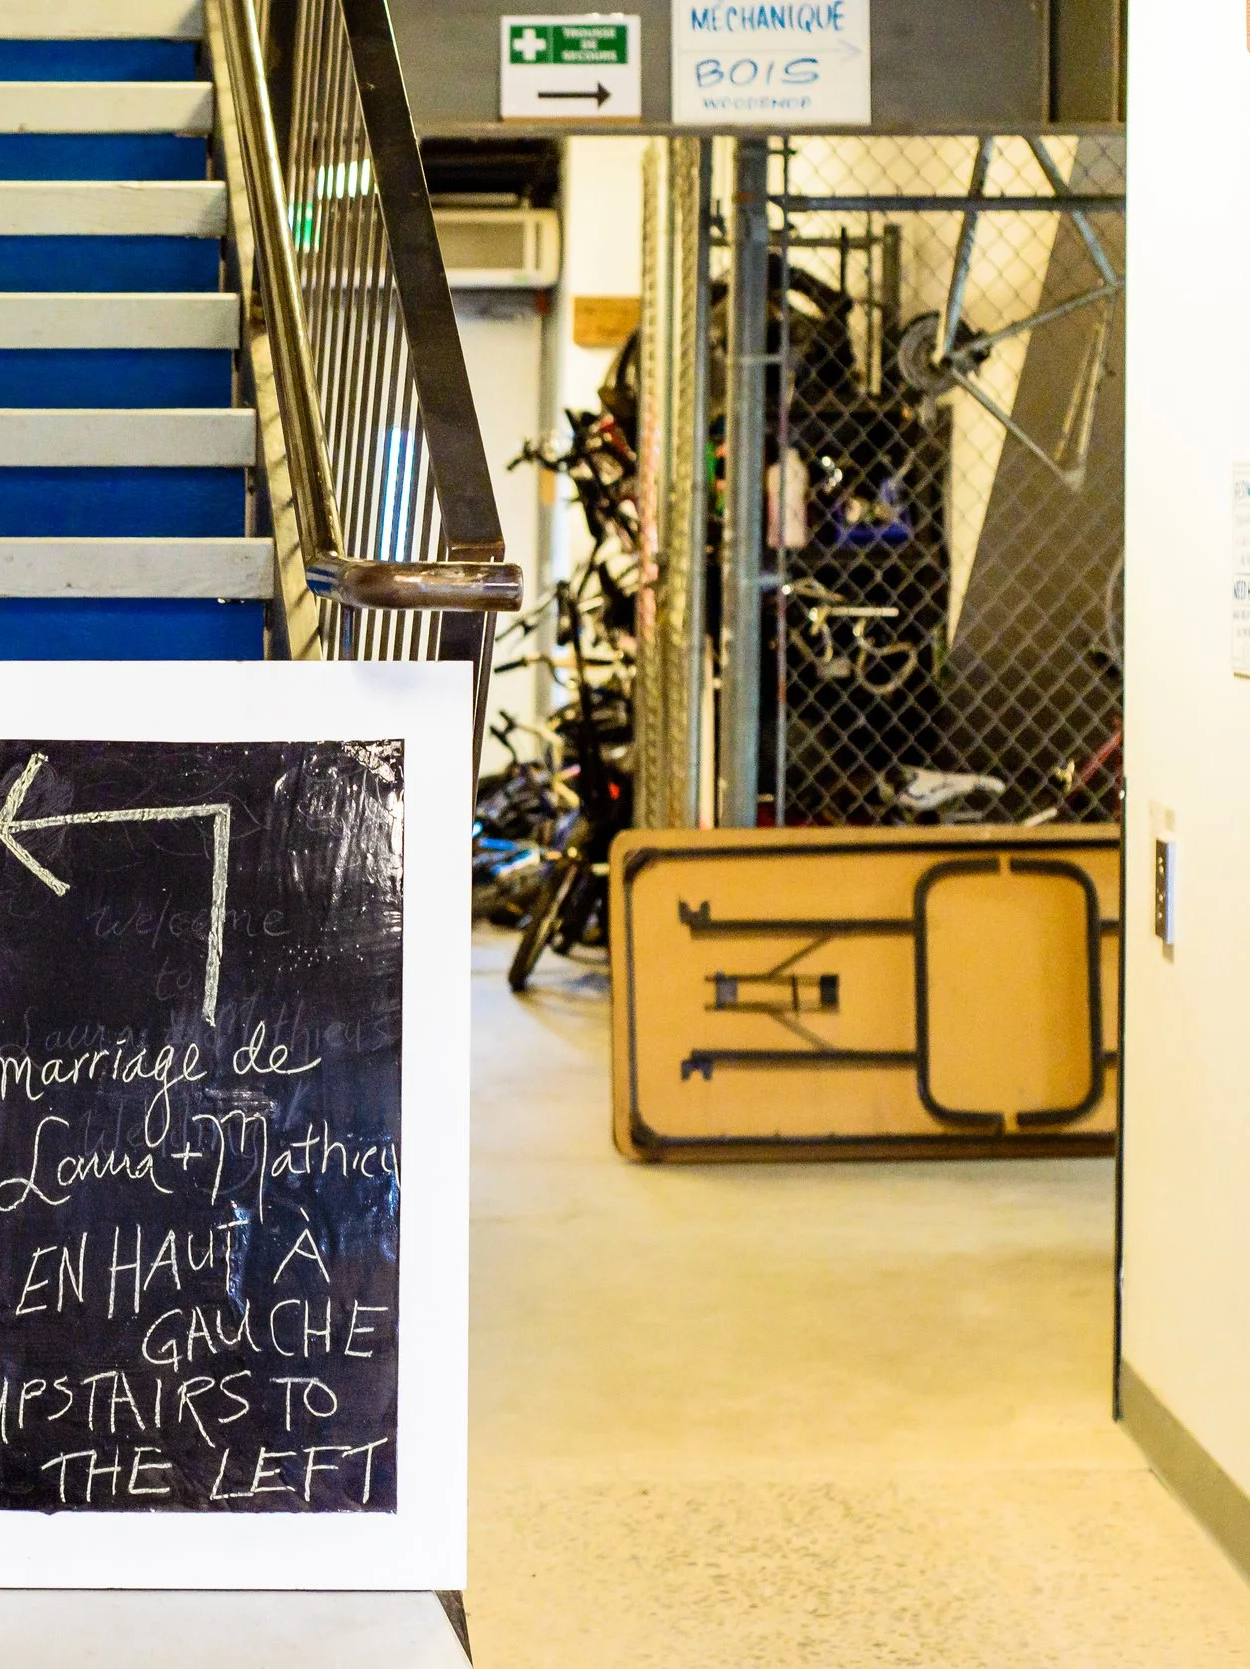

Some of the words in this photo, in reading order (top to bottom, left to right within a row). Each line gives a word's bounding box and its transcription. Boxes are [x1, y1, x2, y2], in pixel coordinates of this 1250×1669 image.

[696, 57, 819, 88] BOIS
[232, 1021, 322, 1075] de
[14, 1231, 87, 1316] EN
[107, 1219, 251, 1318] HAUT
[273, 1211, 330, 1284] À
[141, 1299, 389, 1371] GAUCHE
[269, 1377, 338, 1432] TO
[40, 1445, 172, 1502] THE
[209, 1437, 389, 1505] LEFT
